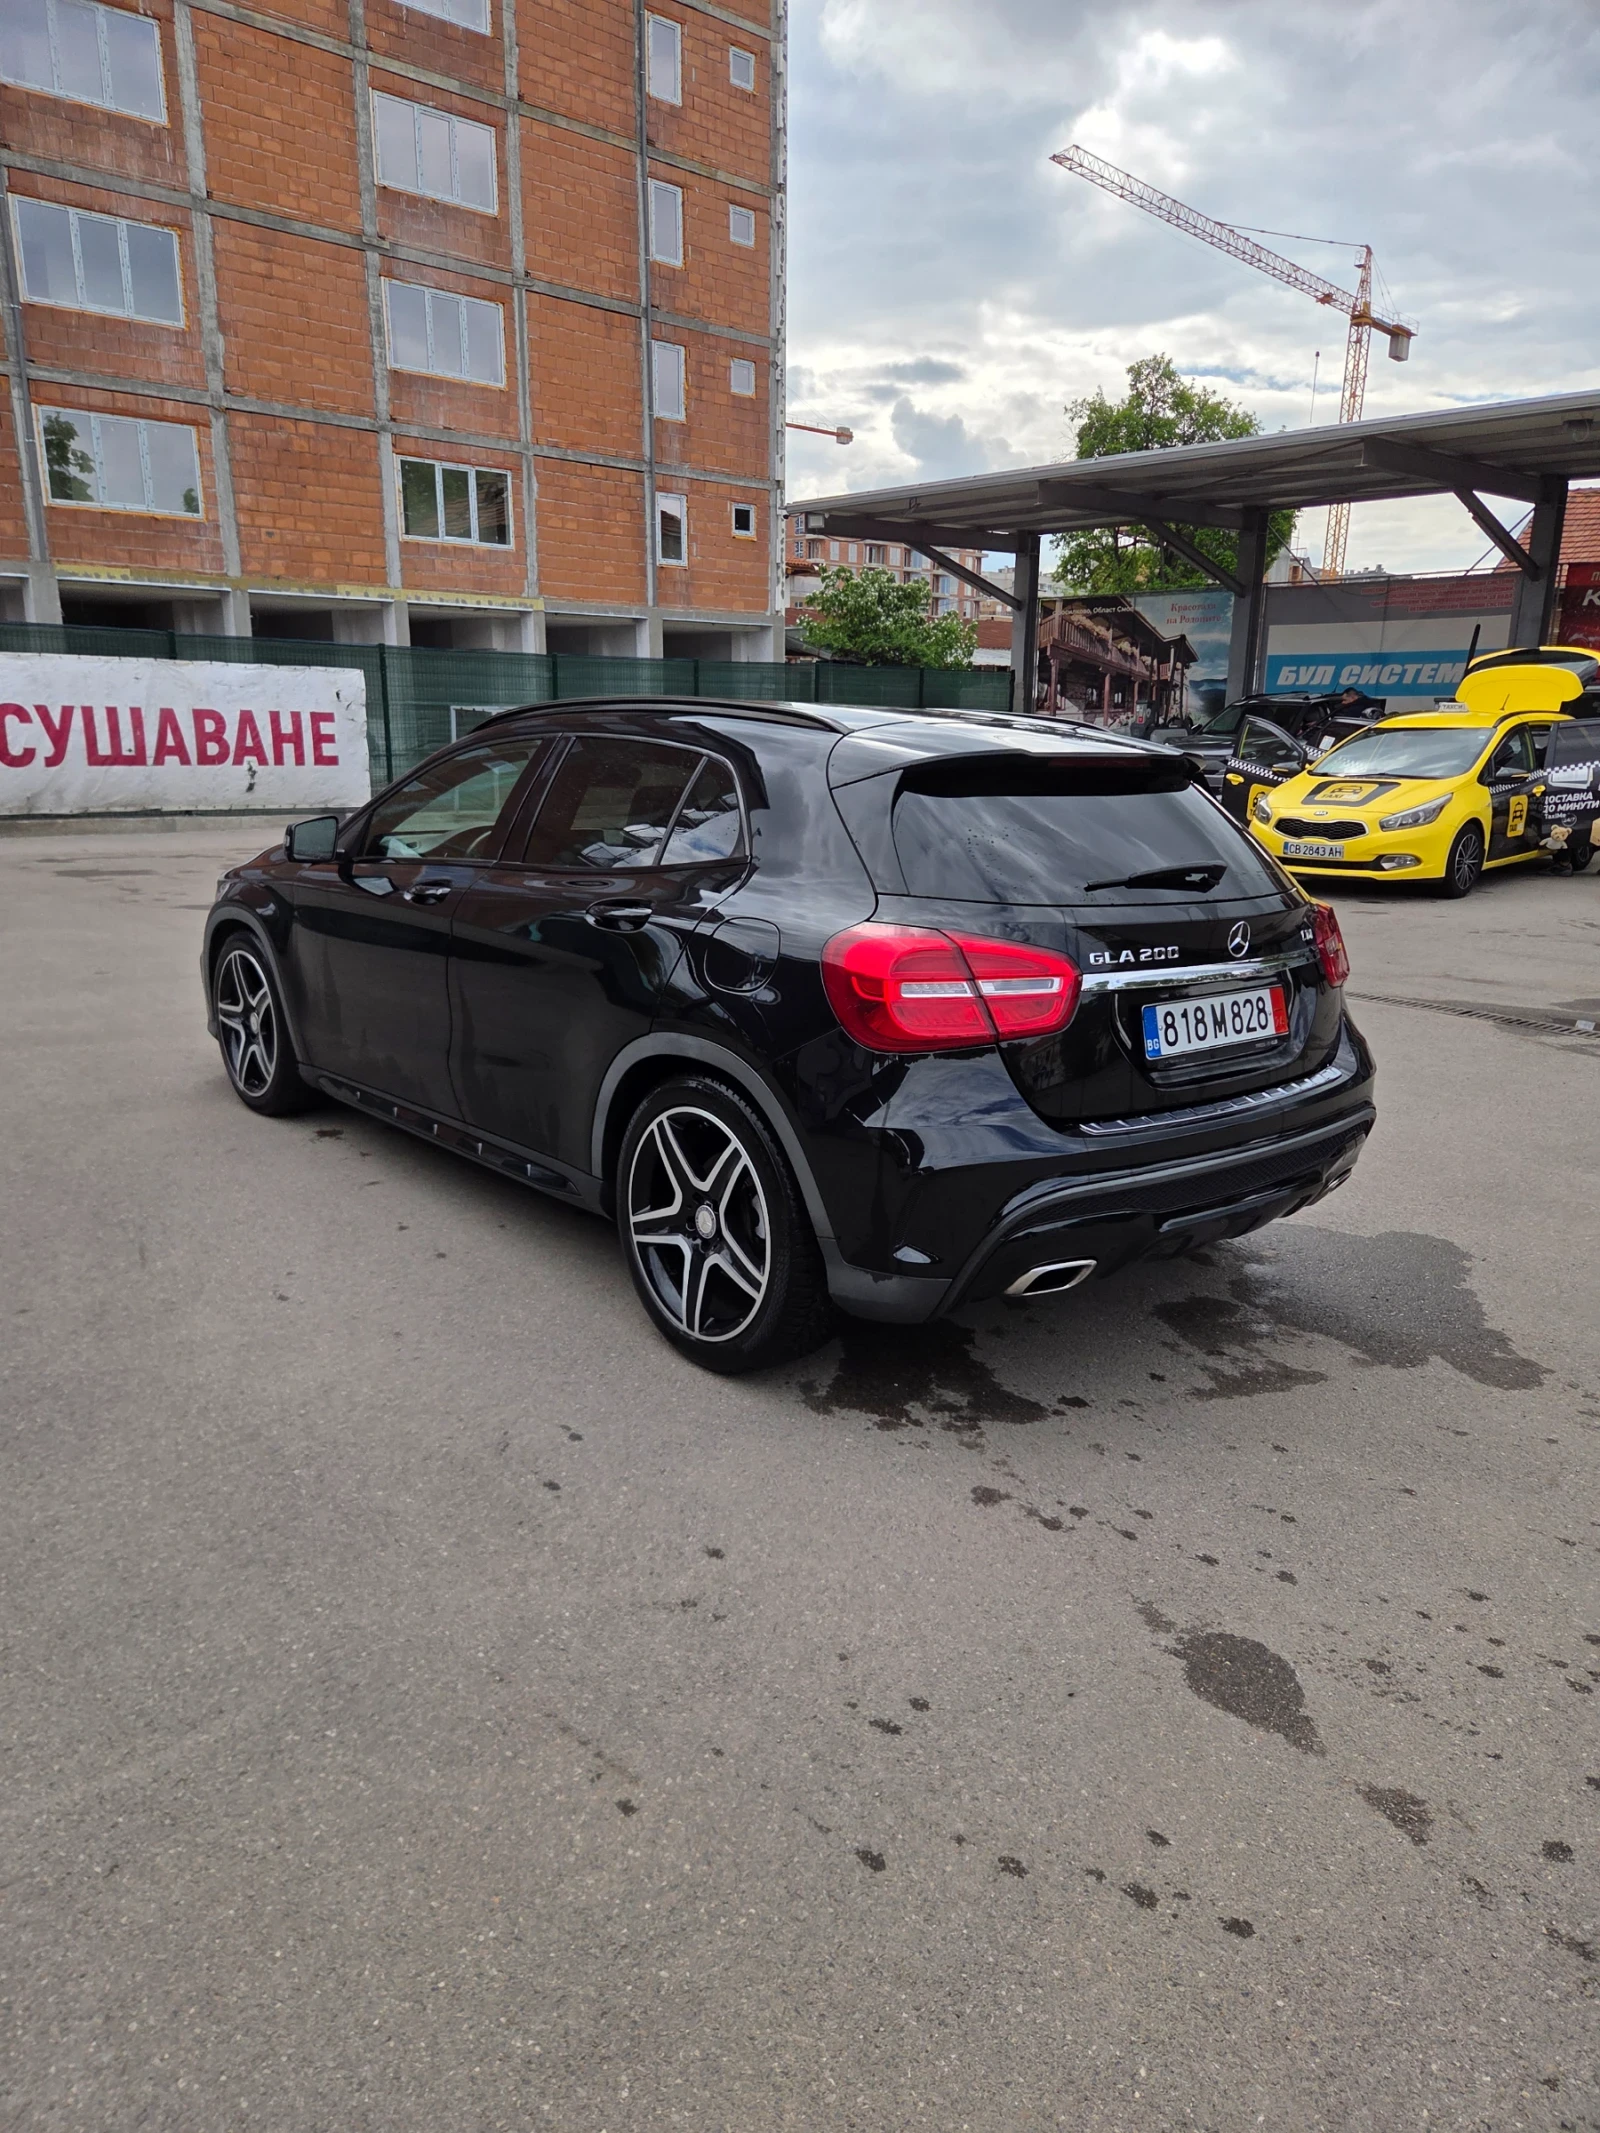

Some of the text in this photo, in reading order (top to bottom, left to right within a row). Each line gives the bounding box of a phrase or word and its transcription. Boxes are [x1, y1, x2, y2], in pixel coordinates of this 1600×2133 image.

[1277, 665, 1336, 686] БУЛ
[0, 702, 340, 768] СУШАВАНЕ
[1557, 800, 1600, 812] МИНУТИ
[1303, 845, 1326, 856] 2843
[1089, 945, 1180, 965] GLA 200
[1147, 1039, 1160, 1051] BG
